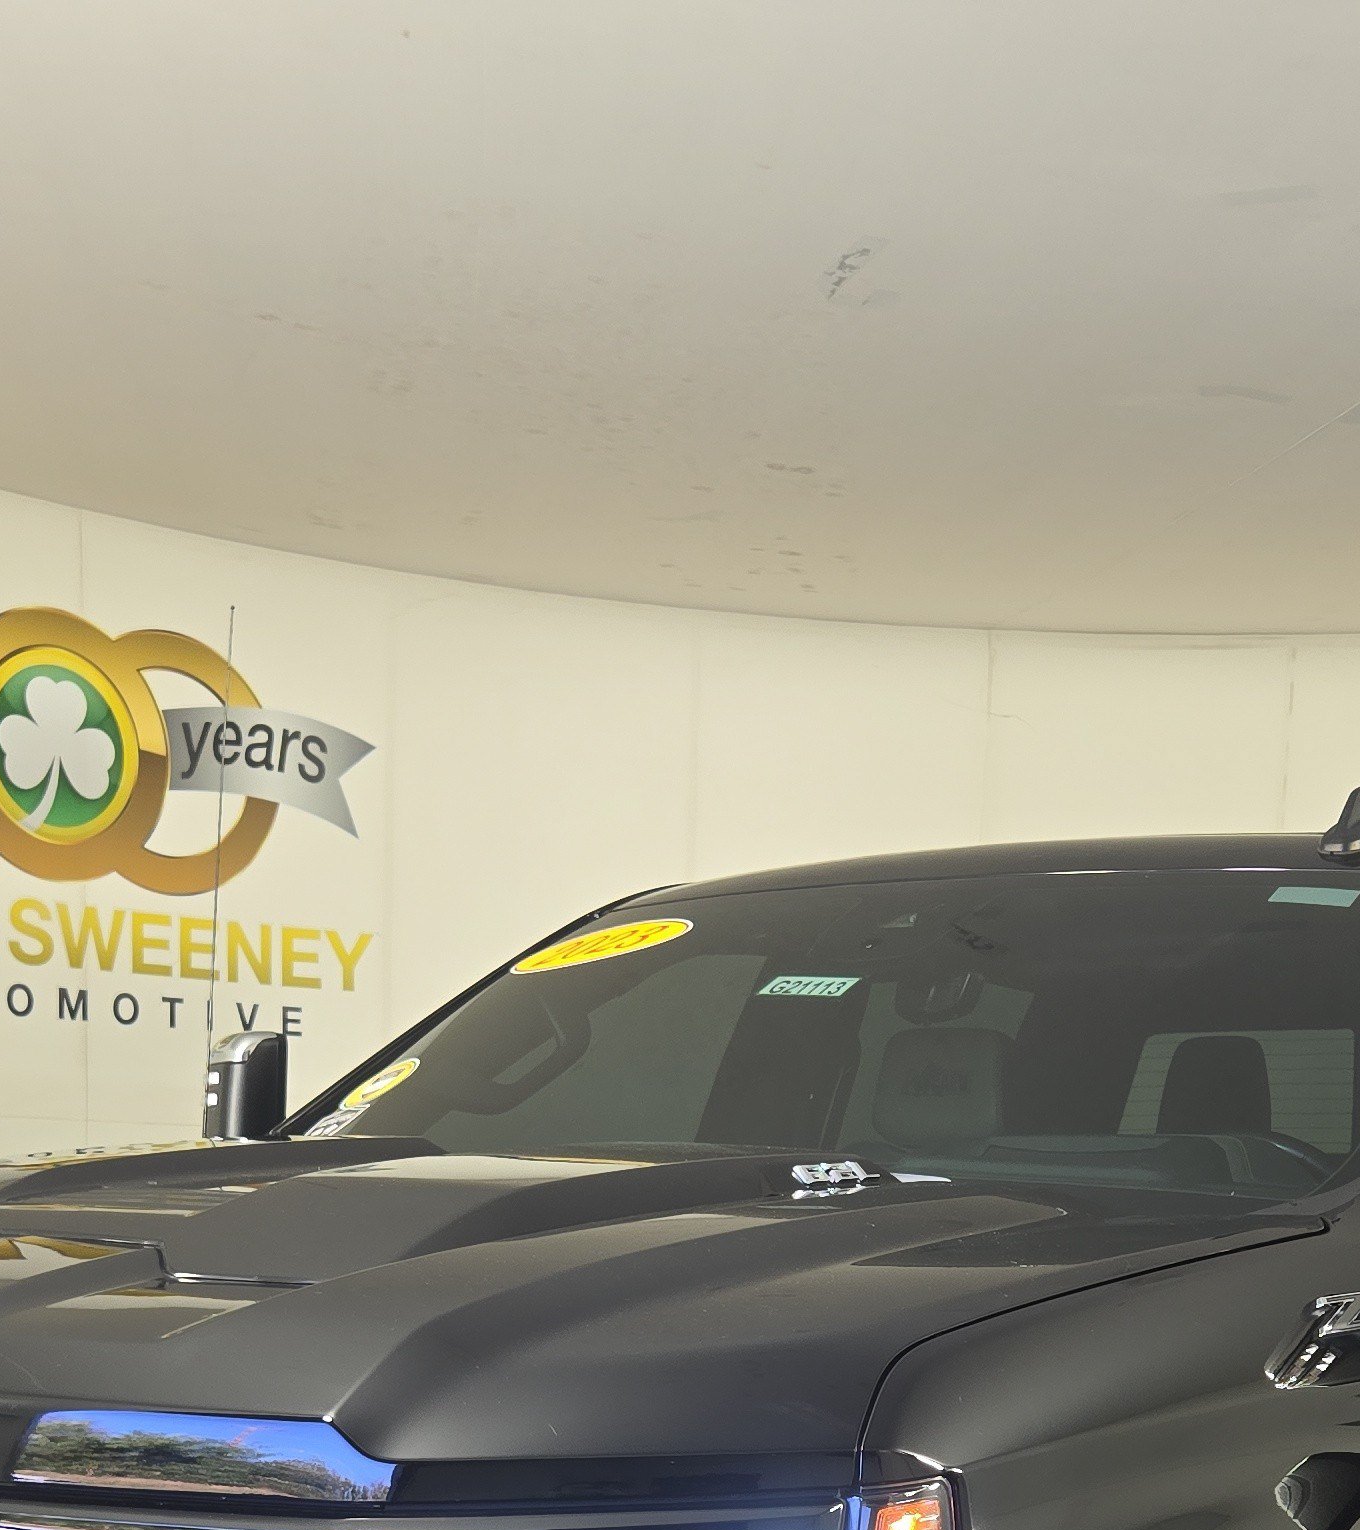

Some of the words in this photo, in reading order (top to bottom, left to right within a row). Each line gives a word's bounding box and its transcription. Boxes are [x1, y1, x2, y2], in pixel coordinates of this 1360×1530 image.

[180, 717, 330, 784] years
[7, 897, 375, 992] SWEENEY
[769, 979, 847, 996] G21113
